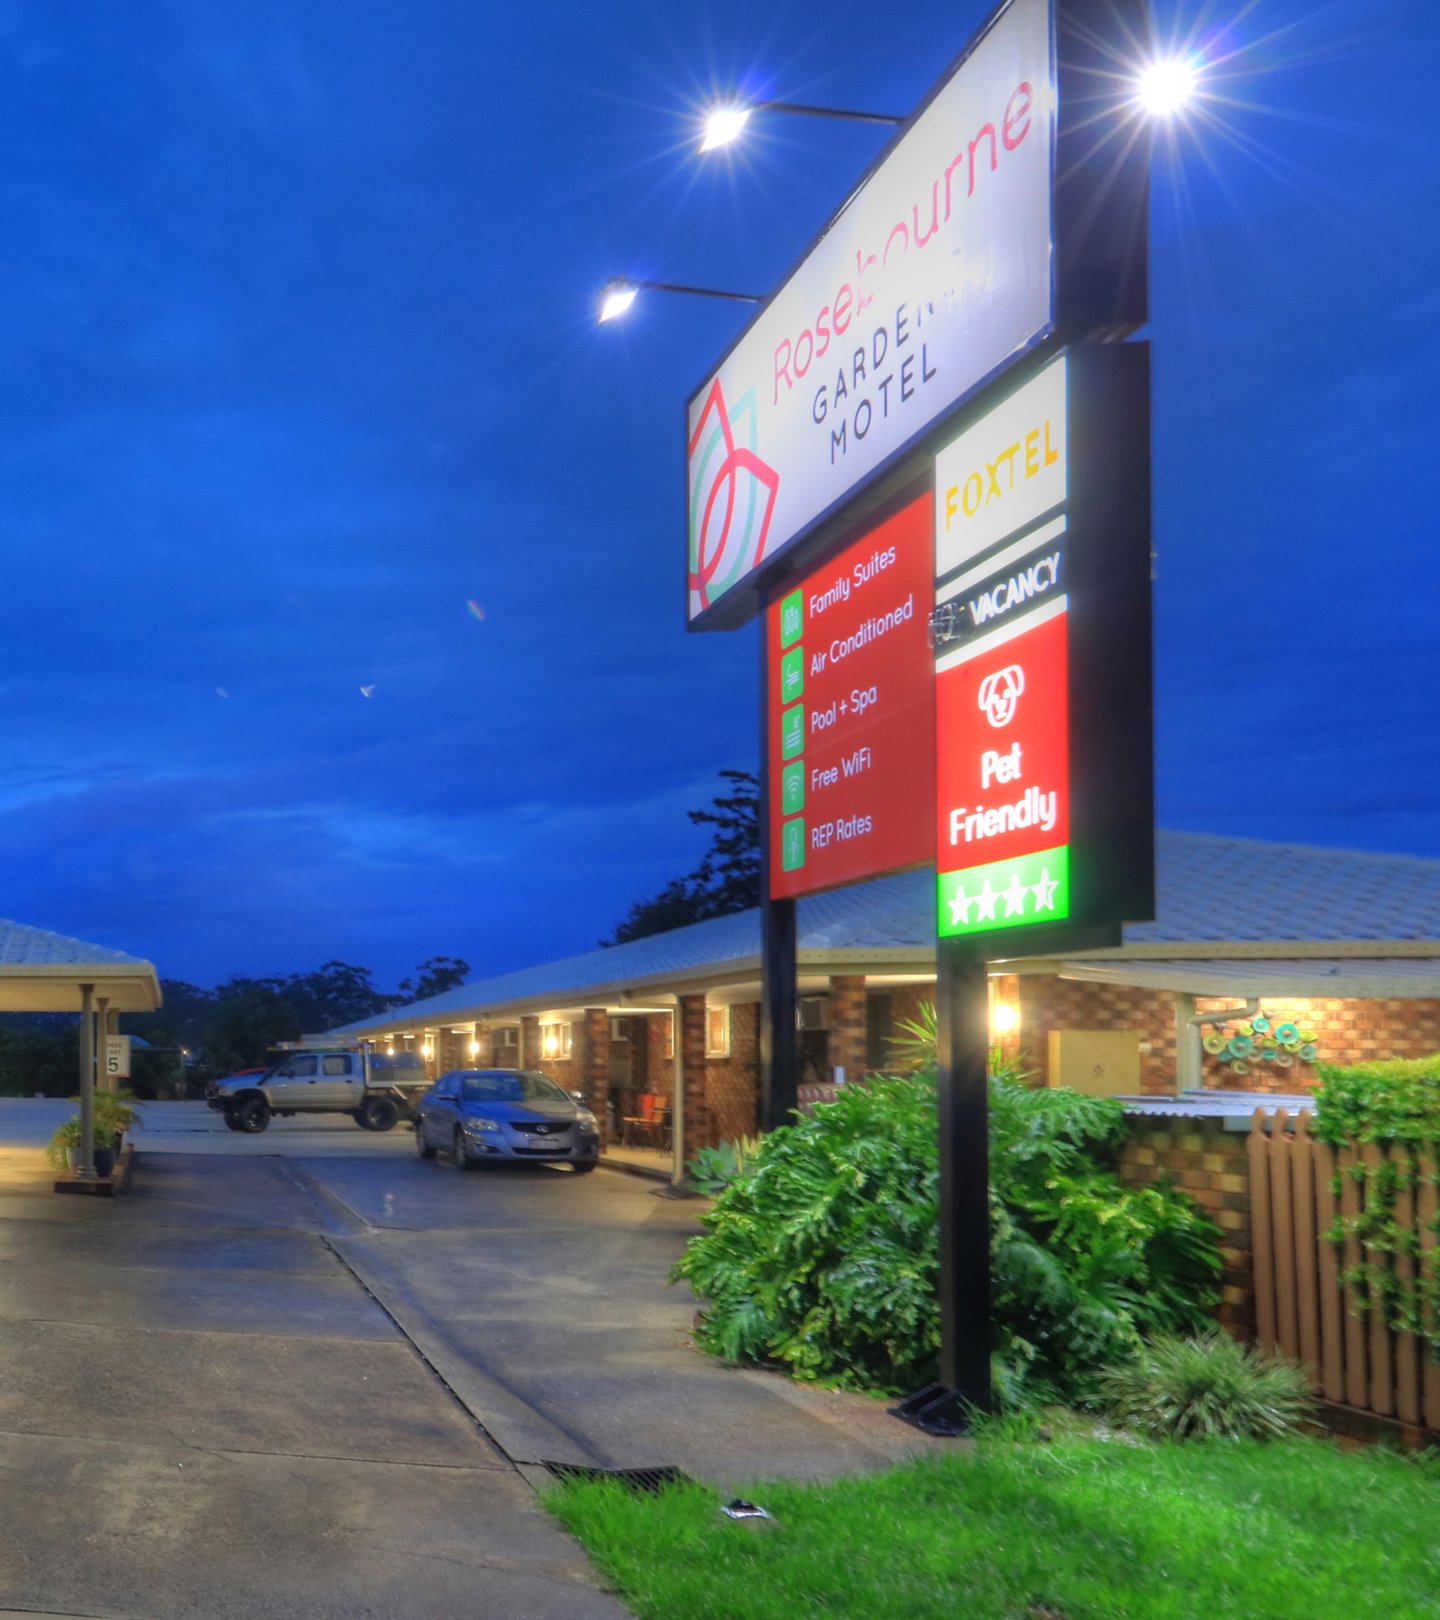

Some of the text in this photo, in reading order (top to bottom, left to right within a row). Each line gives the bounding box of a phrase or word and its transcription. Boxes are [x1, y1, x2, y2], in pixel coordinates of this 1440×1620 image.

[773, 81, 1033, 405] Rosebourne
[830, 343, 938, 465] MOTEL
[945, 418, 1059, 533] FOXTEL
[810, 546, 897, 619] Family Suites
[970, 551, 1061, 626] VACANCY
[810, 593, 914, 677] Air Conditioned
[811, 702, 837, 733] Pool
[850, 685, 878, 715] Spa
[811, 747, 872, 792] Free WiFi
[981, 742, 1023, 790] Pet
[811, 814, 873, 850] REP Rates
[949, 785, 1057, 846] Friendly
[107, 1057, 119, 1072] 5
